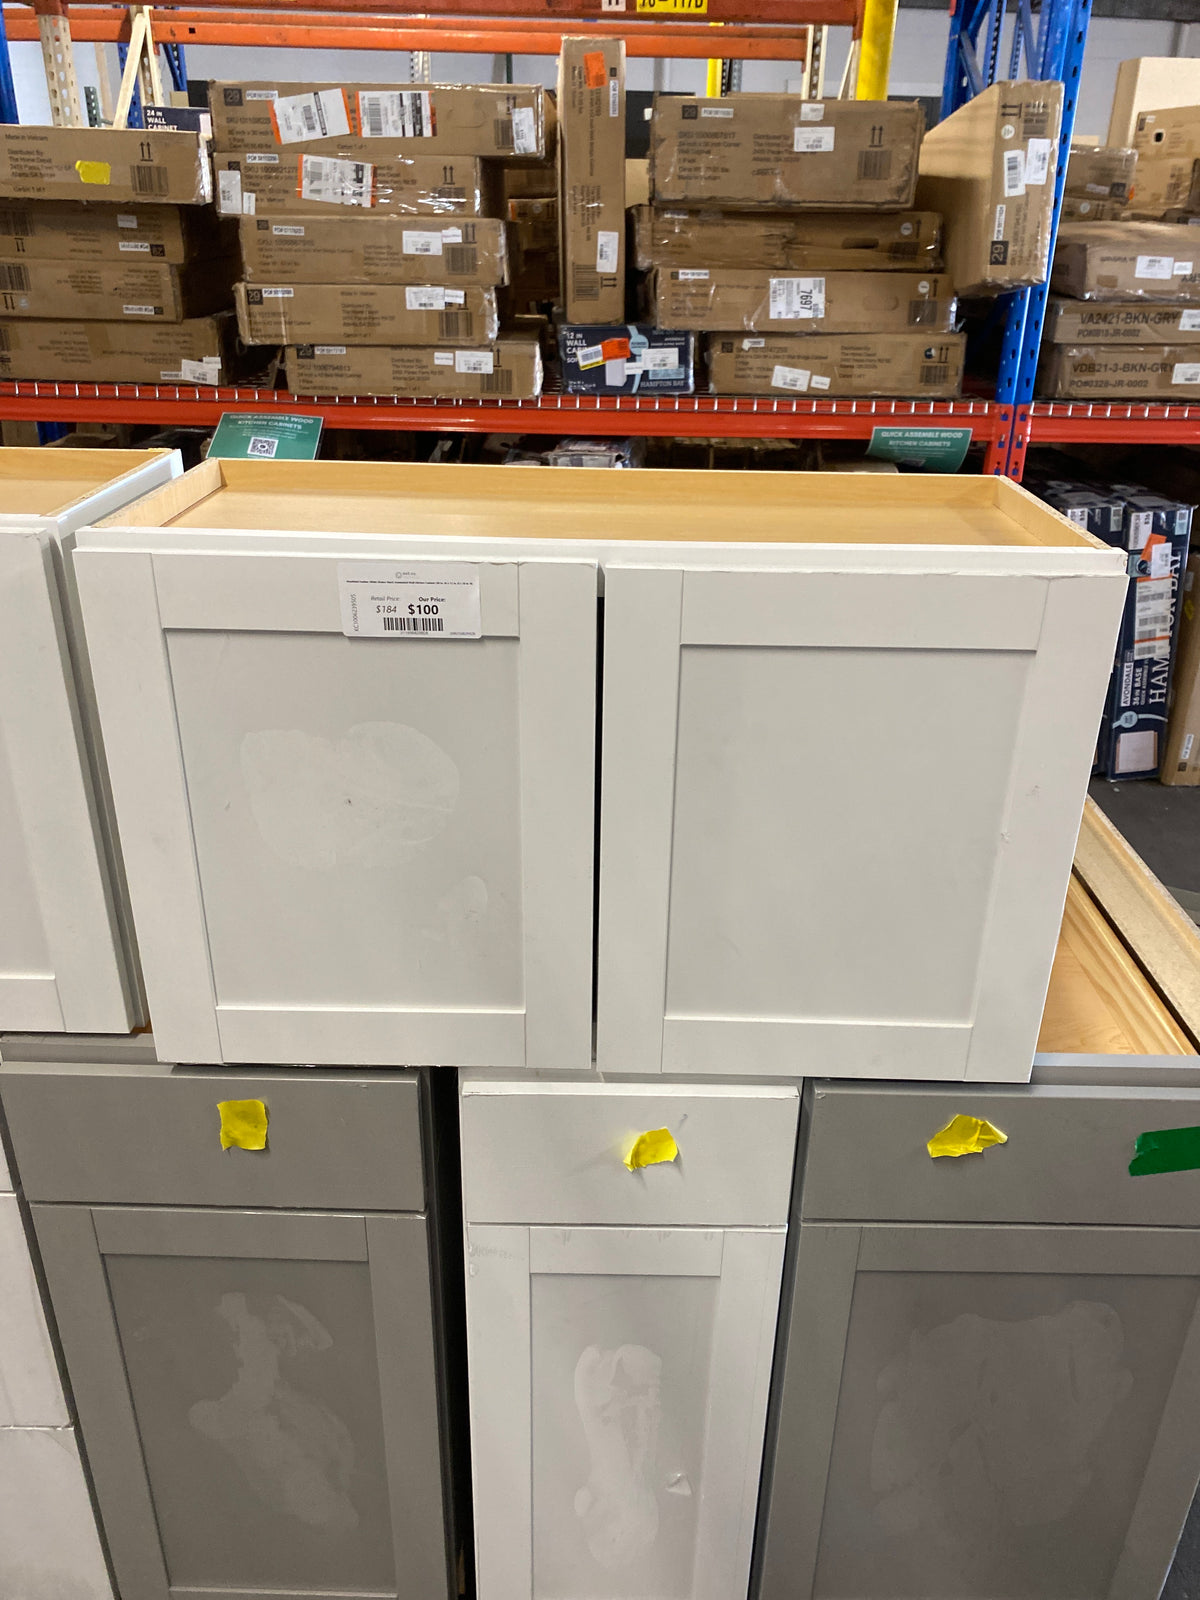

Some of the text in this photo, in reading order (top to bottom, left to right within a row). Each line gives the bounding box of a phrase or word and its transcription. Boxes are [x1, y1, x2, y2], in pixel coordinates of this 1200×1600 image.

[992, 244, 1004, 262] 29
[800, 289, 813, 311] 7697
[268, 421, 302, 430] CABINETS
[290, 416, 314, 424] WOOD
[940, 431, 963, 439] WOOD
[376, 603, 439, 616] $184 $100
[1123, 663, 1132, 705] AVONDALE
[1134, 667, 1143, 688] BASE
[1132, 697, 1140, 706] 36
